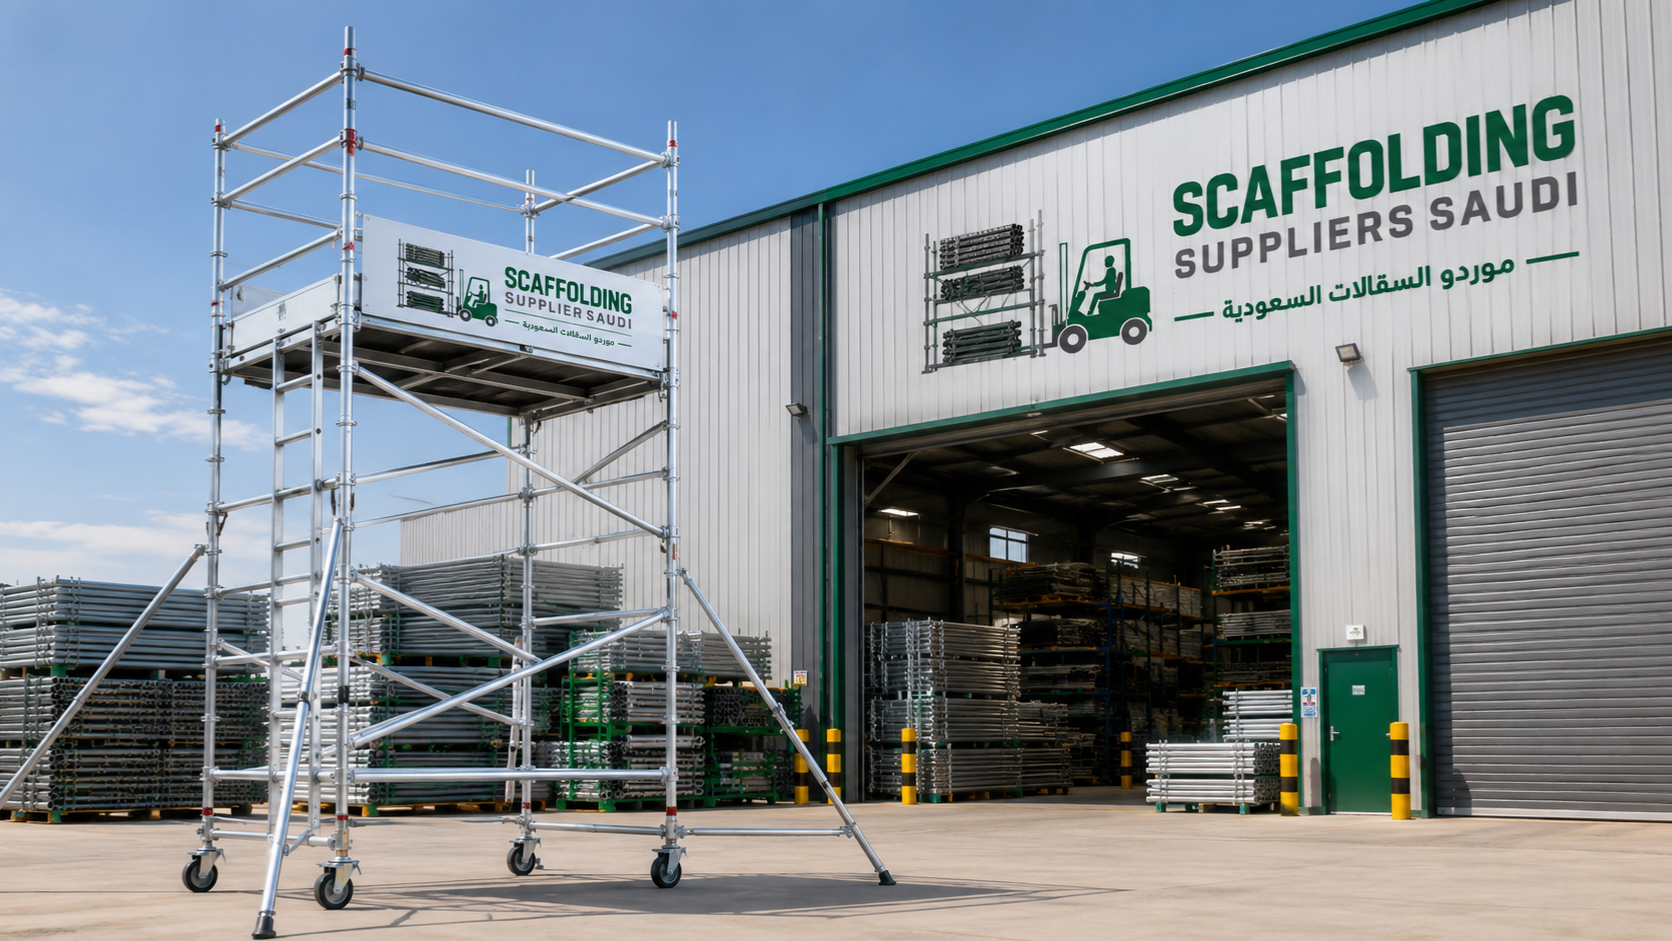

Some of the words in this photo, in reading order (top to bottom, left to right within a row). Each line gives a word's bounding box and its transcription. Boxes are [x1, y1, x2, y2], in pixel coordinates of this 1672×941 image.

[1173, 95, 1576, 238] SCAFFOLDING
[1175, 204, 1414, 279] SUPPLIERS
[1430, 172, 1578, 231] SAUDI
[504, 266, 632, 315] SCAFFOLDING
[1328, 264, 1432, 303] السقالات
[1440, 258, 1515, 291] موردو
[505, 291, 582, 319] SUPPLIER
[586, 309, 632, 330] SAUDI
[1222, 285, 1322, 323] السعودية
